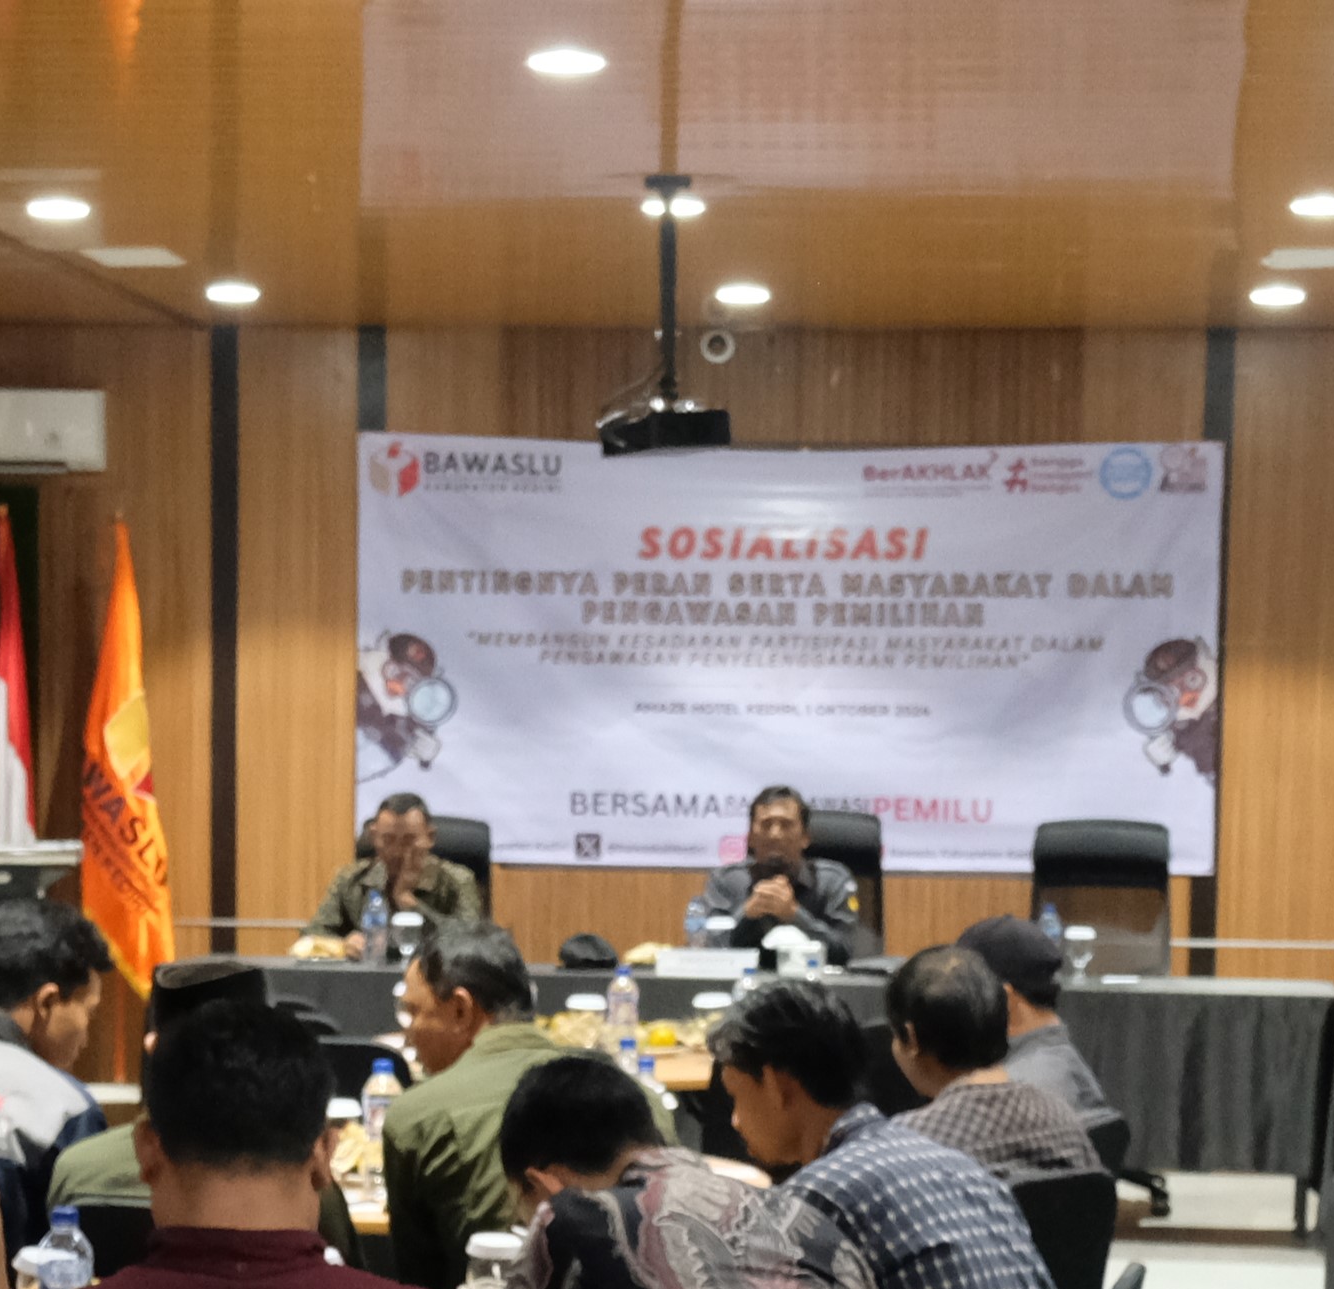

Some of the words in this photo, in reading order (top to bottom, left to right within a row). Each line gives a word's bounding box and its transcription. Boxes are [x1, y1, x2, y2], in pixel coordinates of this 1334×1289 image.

[424, 451, 562, 476] BAWASLU
[637, 525, 929, 561] SOSIALISASI
[401, 568, 599, 595] PENTINGNYA
[613, 571, 712, 597] PERAN
[727, 572, 827, 598] SERTA
[840, 572, 1052, 598] MASYARAKAT
[1067, 572, 1174, 599] DALAM
[581, 599, 797, 626] PENGAWASAN
[812, 601, 985, 627] PEMILIHAN
[569, 791, 721, 818] BERSAMA
[873, 796, 993, 824] PEMILU
